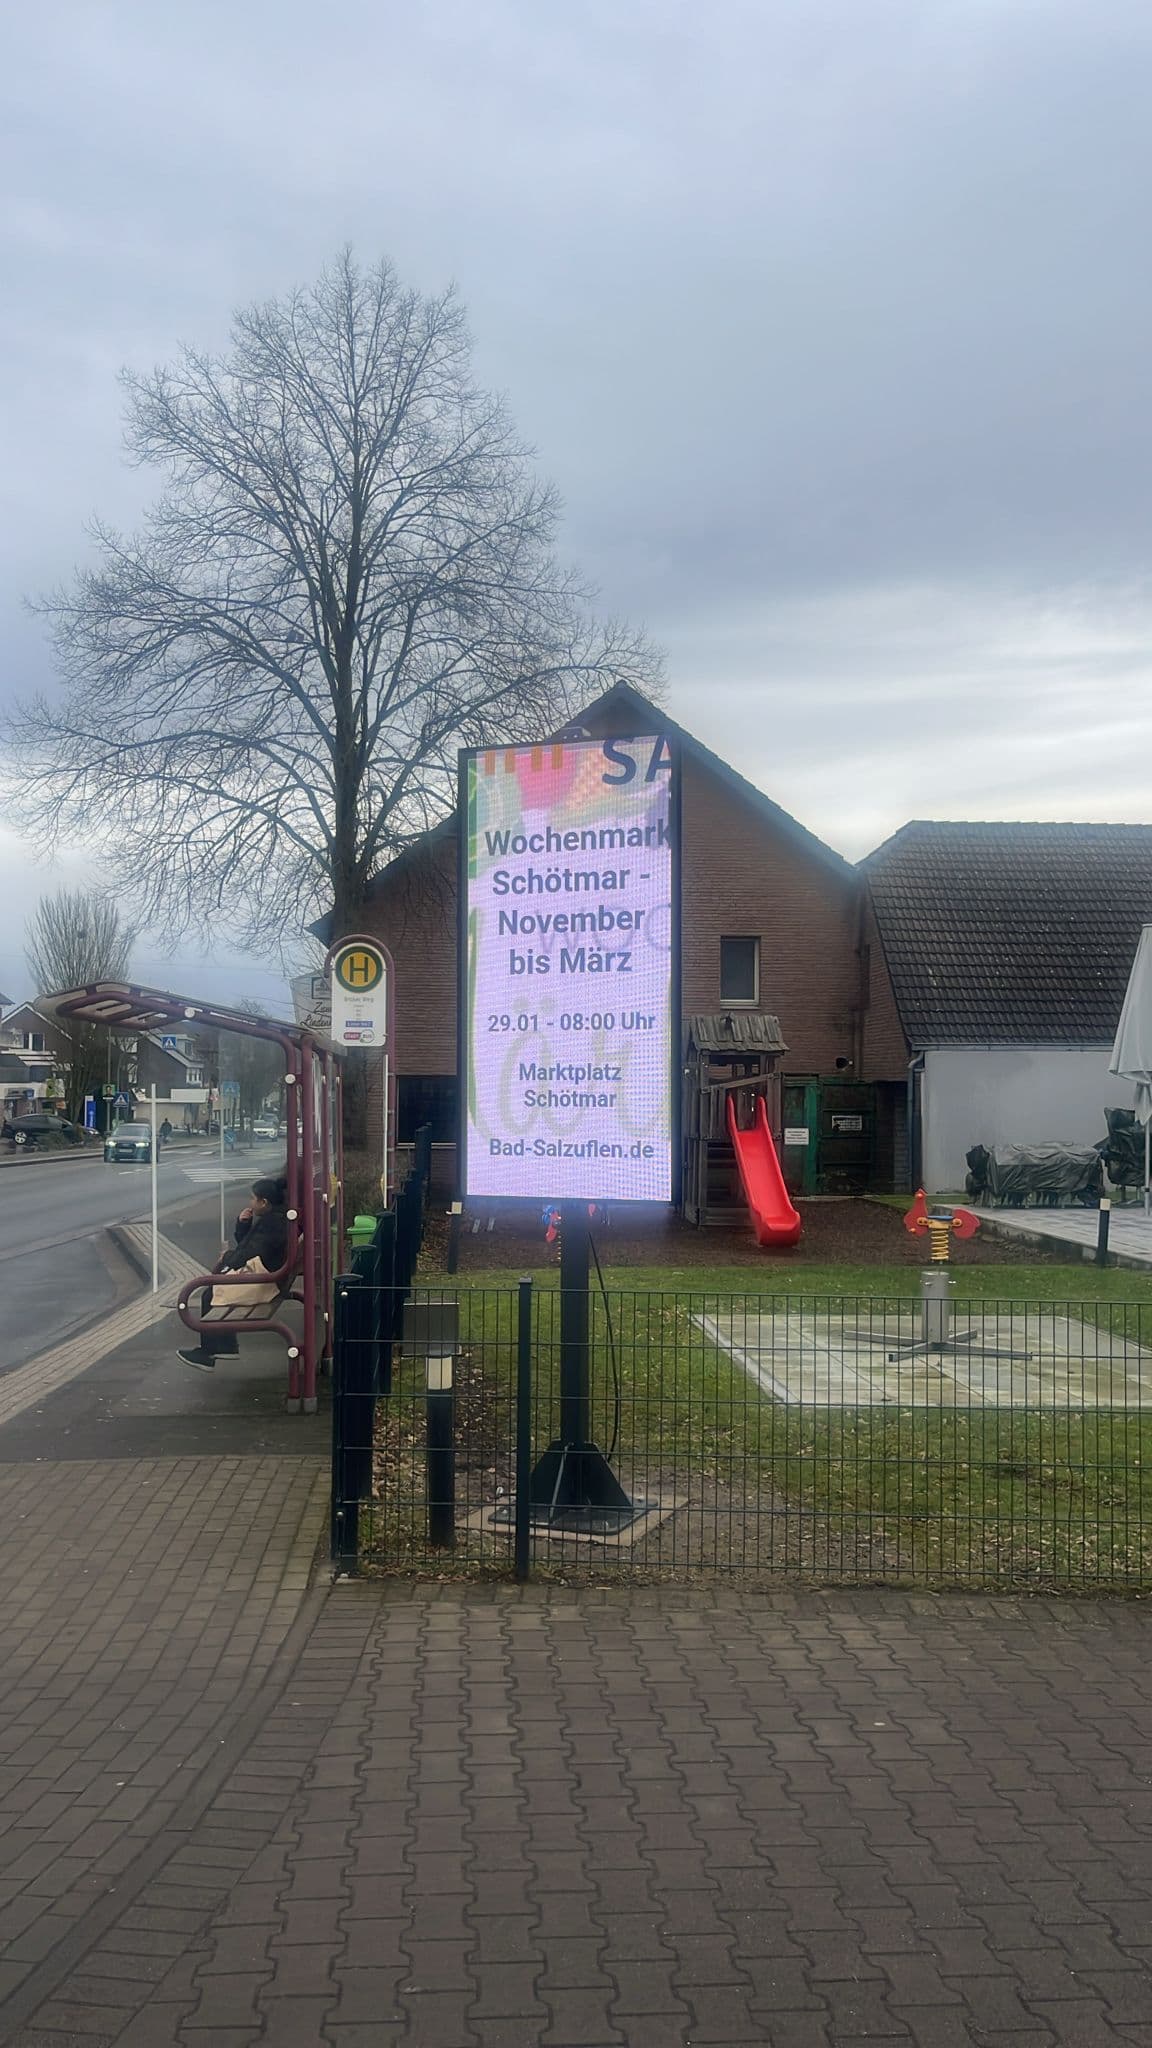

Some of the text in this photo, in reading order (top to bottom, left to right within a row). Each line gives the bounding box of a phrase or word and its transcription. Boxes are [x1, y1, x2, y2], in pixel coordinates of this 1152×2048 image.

[485, 819, 672, 856] Wochenmark
[492, 867, 631, 896] Schötmar
[498, 904, 646, 936] November
[349, 956, 369, 983] H
[509, 946, 633, 975] bis März
[488, 1014, 539, 1032] 29.01
[560, 1013, 615, 1031] 08:00
[621, 1012, 656, 1030] Uhr
[519, 1063, 622, 1085] Marktplatz
[524, 1090, 617, 1108] Schötmar
[489, 1138, 655, 1159] Bad-Salzuflen.de
